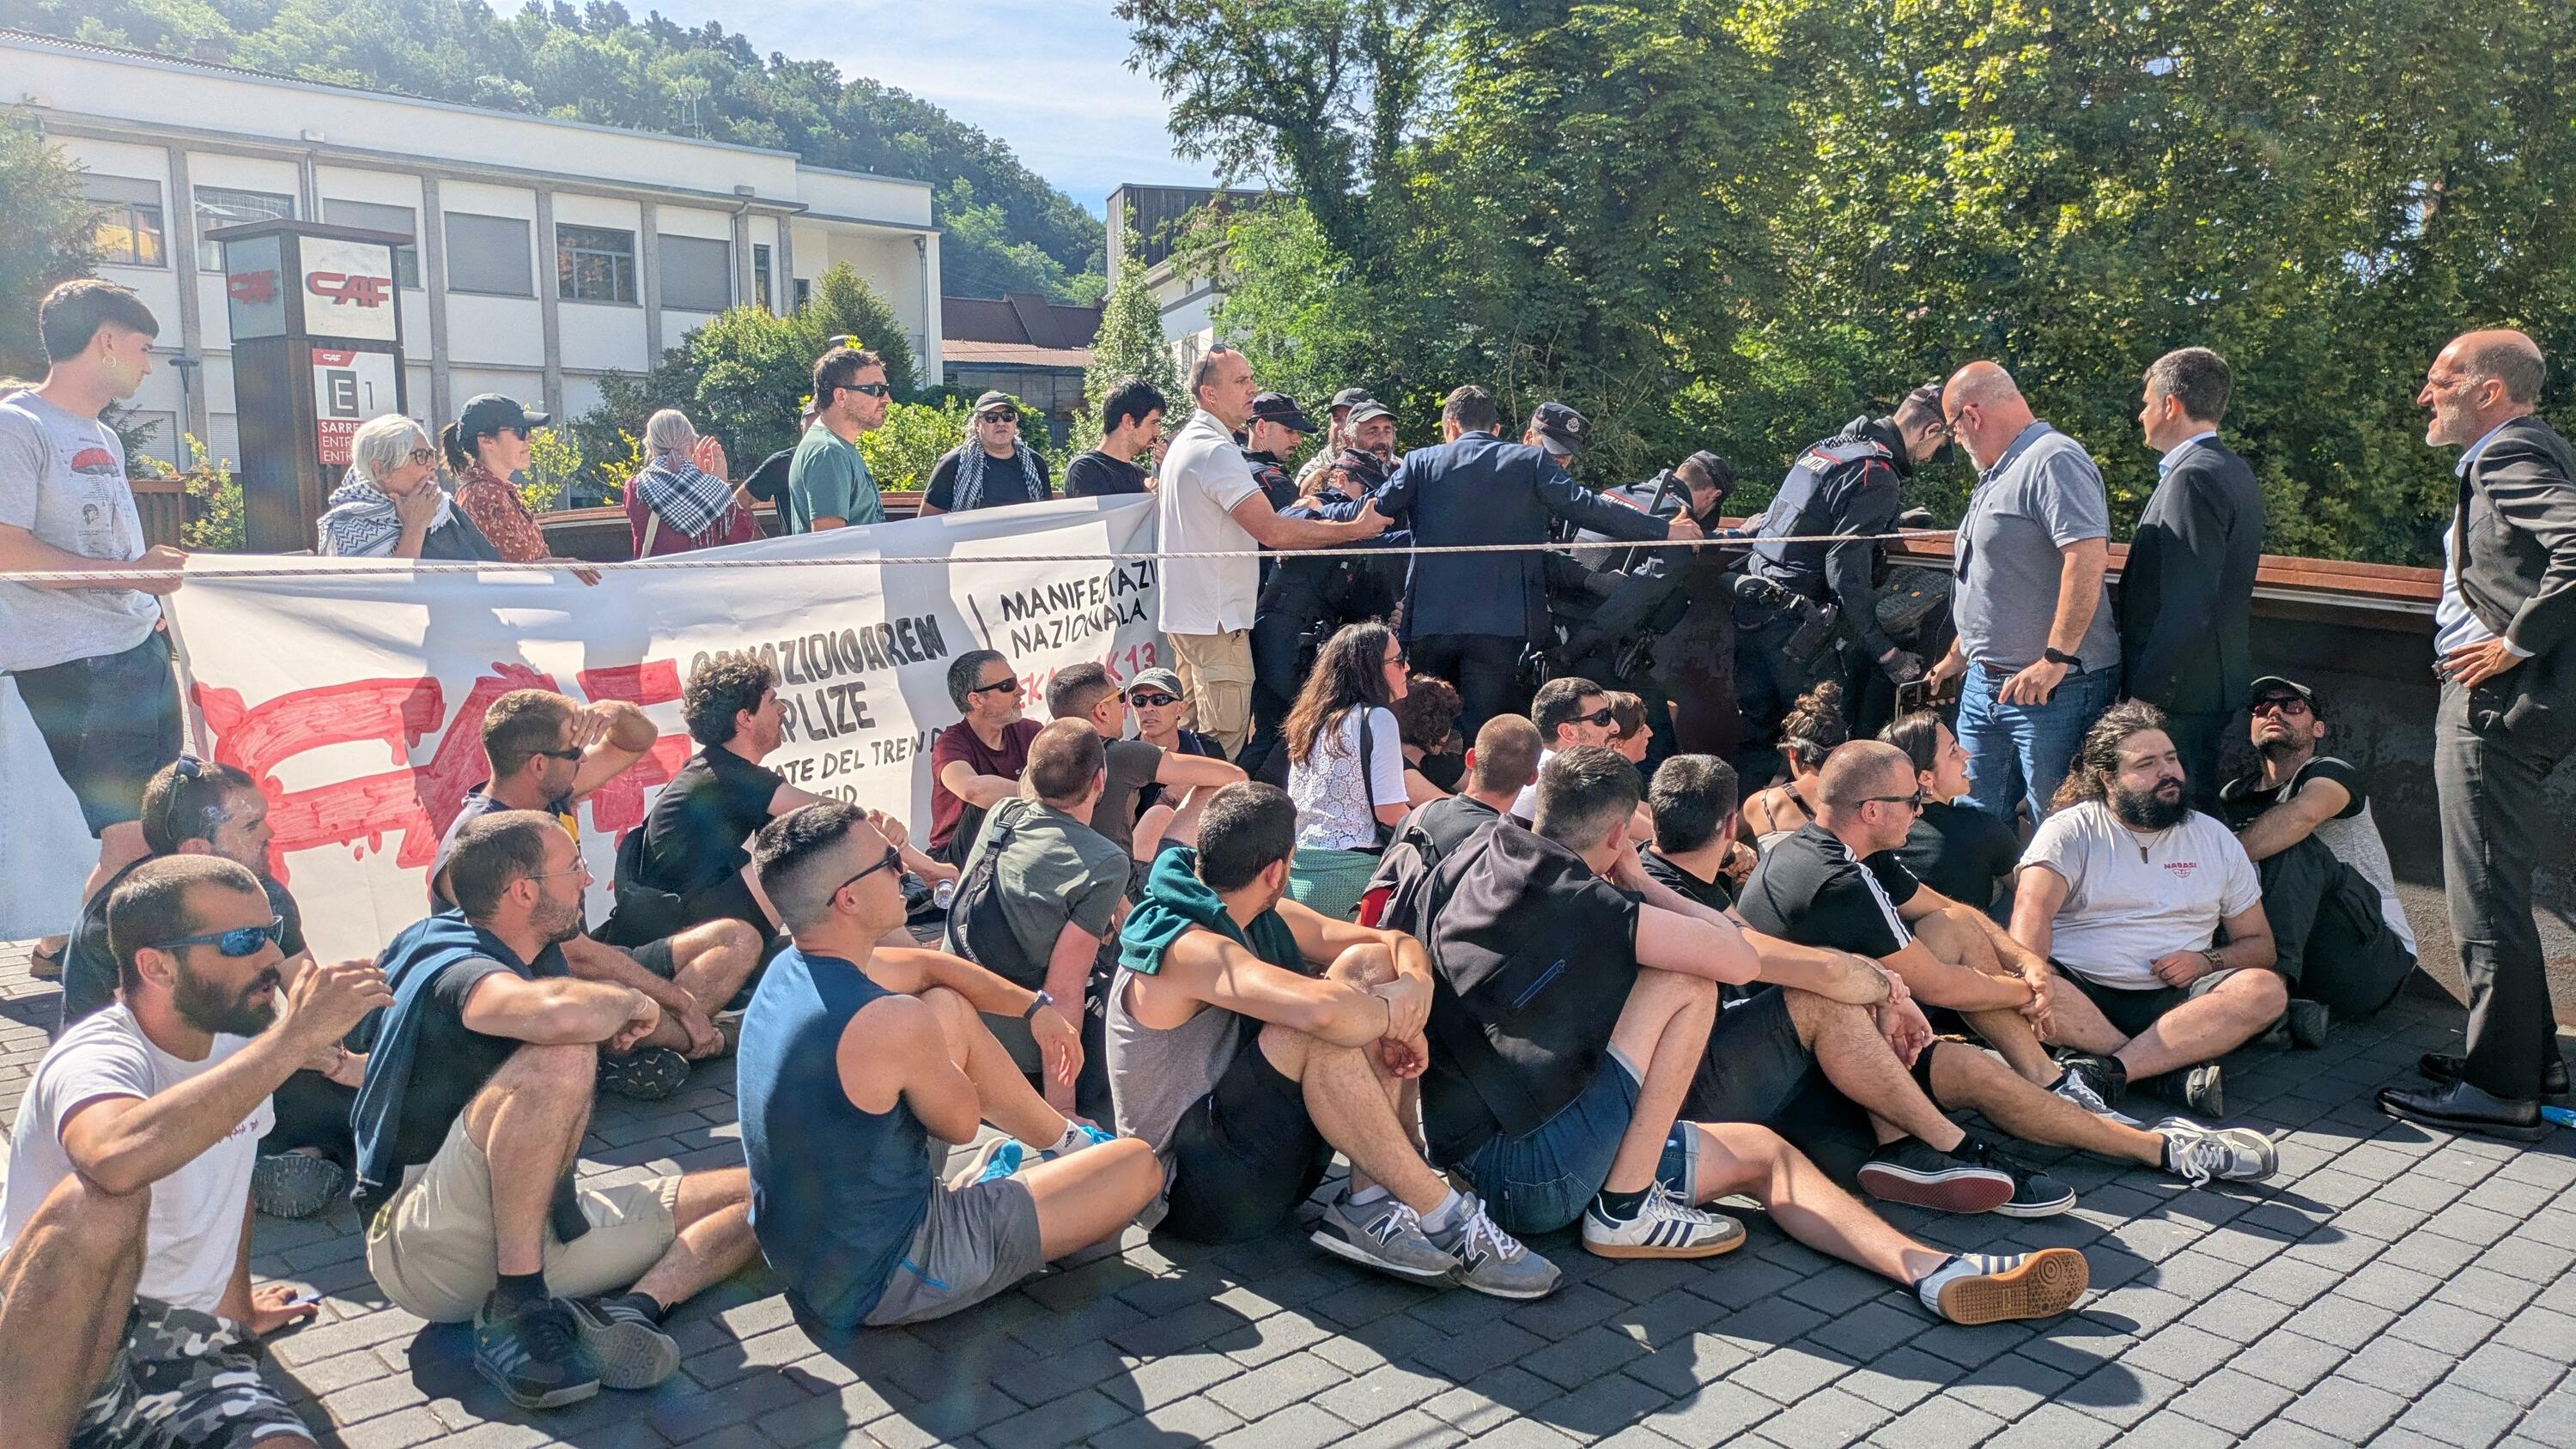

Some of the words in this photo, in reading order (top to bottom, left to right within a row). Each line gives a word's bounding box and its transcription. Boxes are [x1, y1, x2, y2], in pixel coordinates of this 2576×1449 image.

[307, 270, 392, 308] CAF
[322, 354, 342, 362] CAF
[334, 379, 354, 409] E
[365, 380, 374, 410] 1
[322, 436, 353, 447] ENTR
[324, 451, 353, 462] ENTR
[1000, 560, 1157, 622] MANIFESTAZI
[1011, 598, 1148, 658] NAZIONALA
[770, 682, 876, 743] PLIZE
[821, 749, 865, 779] DEL
[871, 731, 926, 767] TREN
